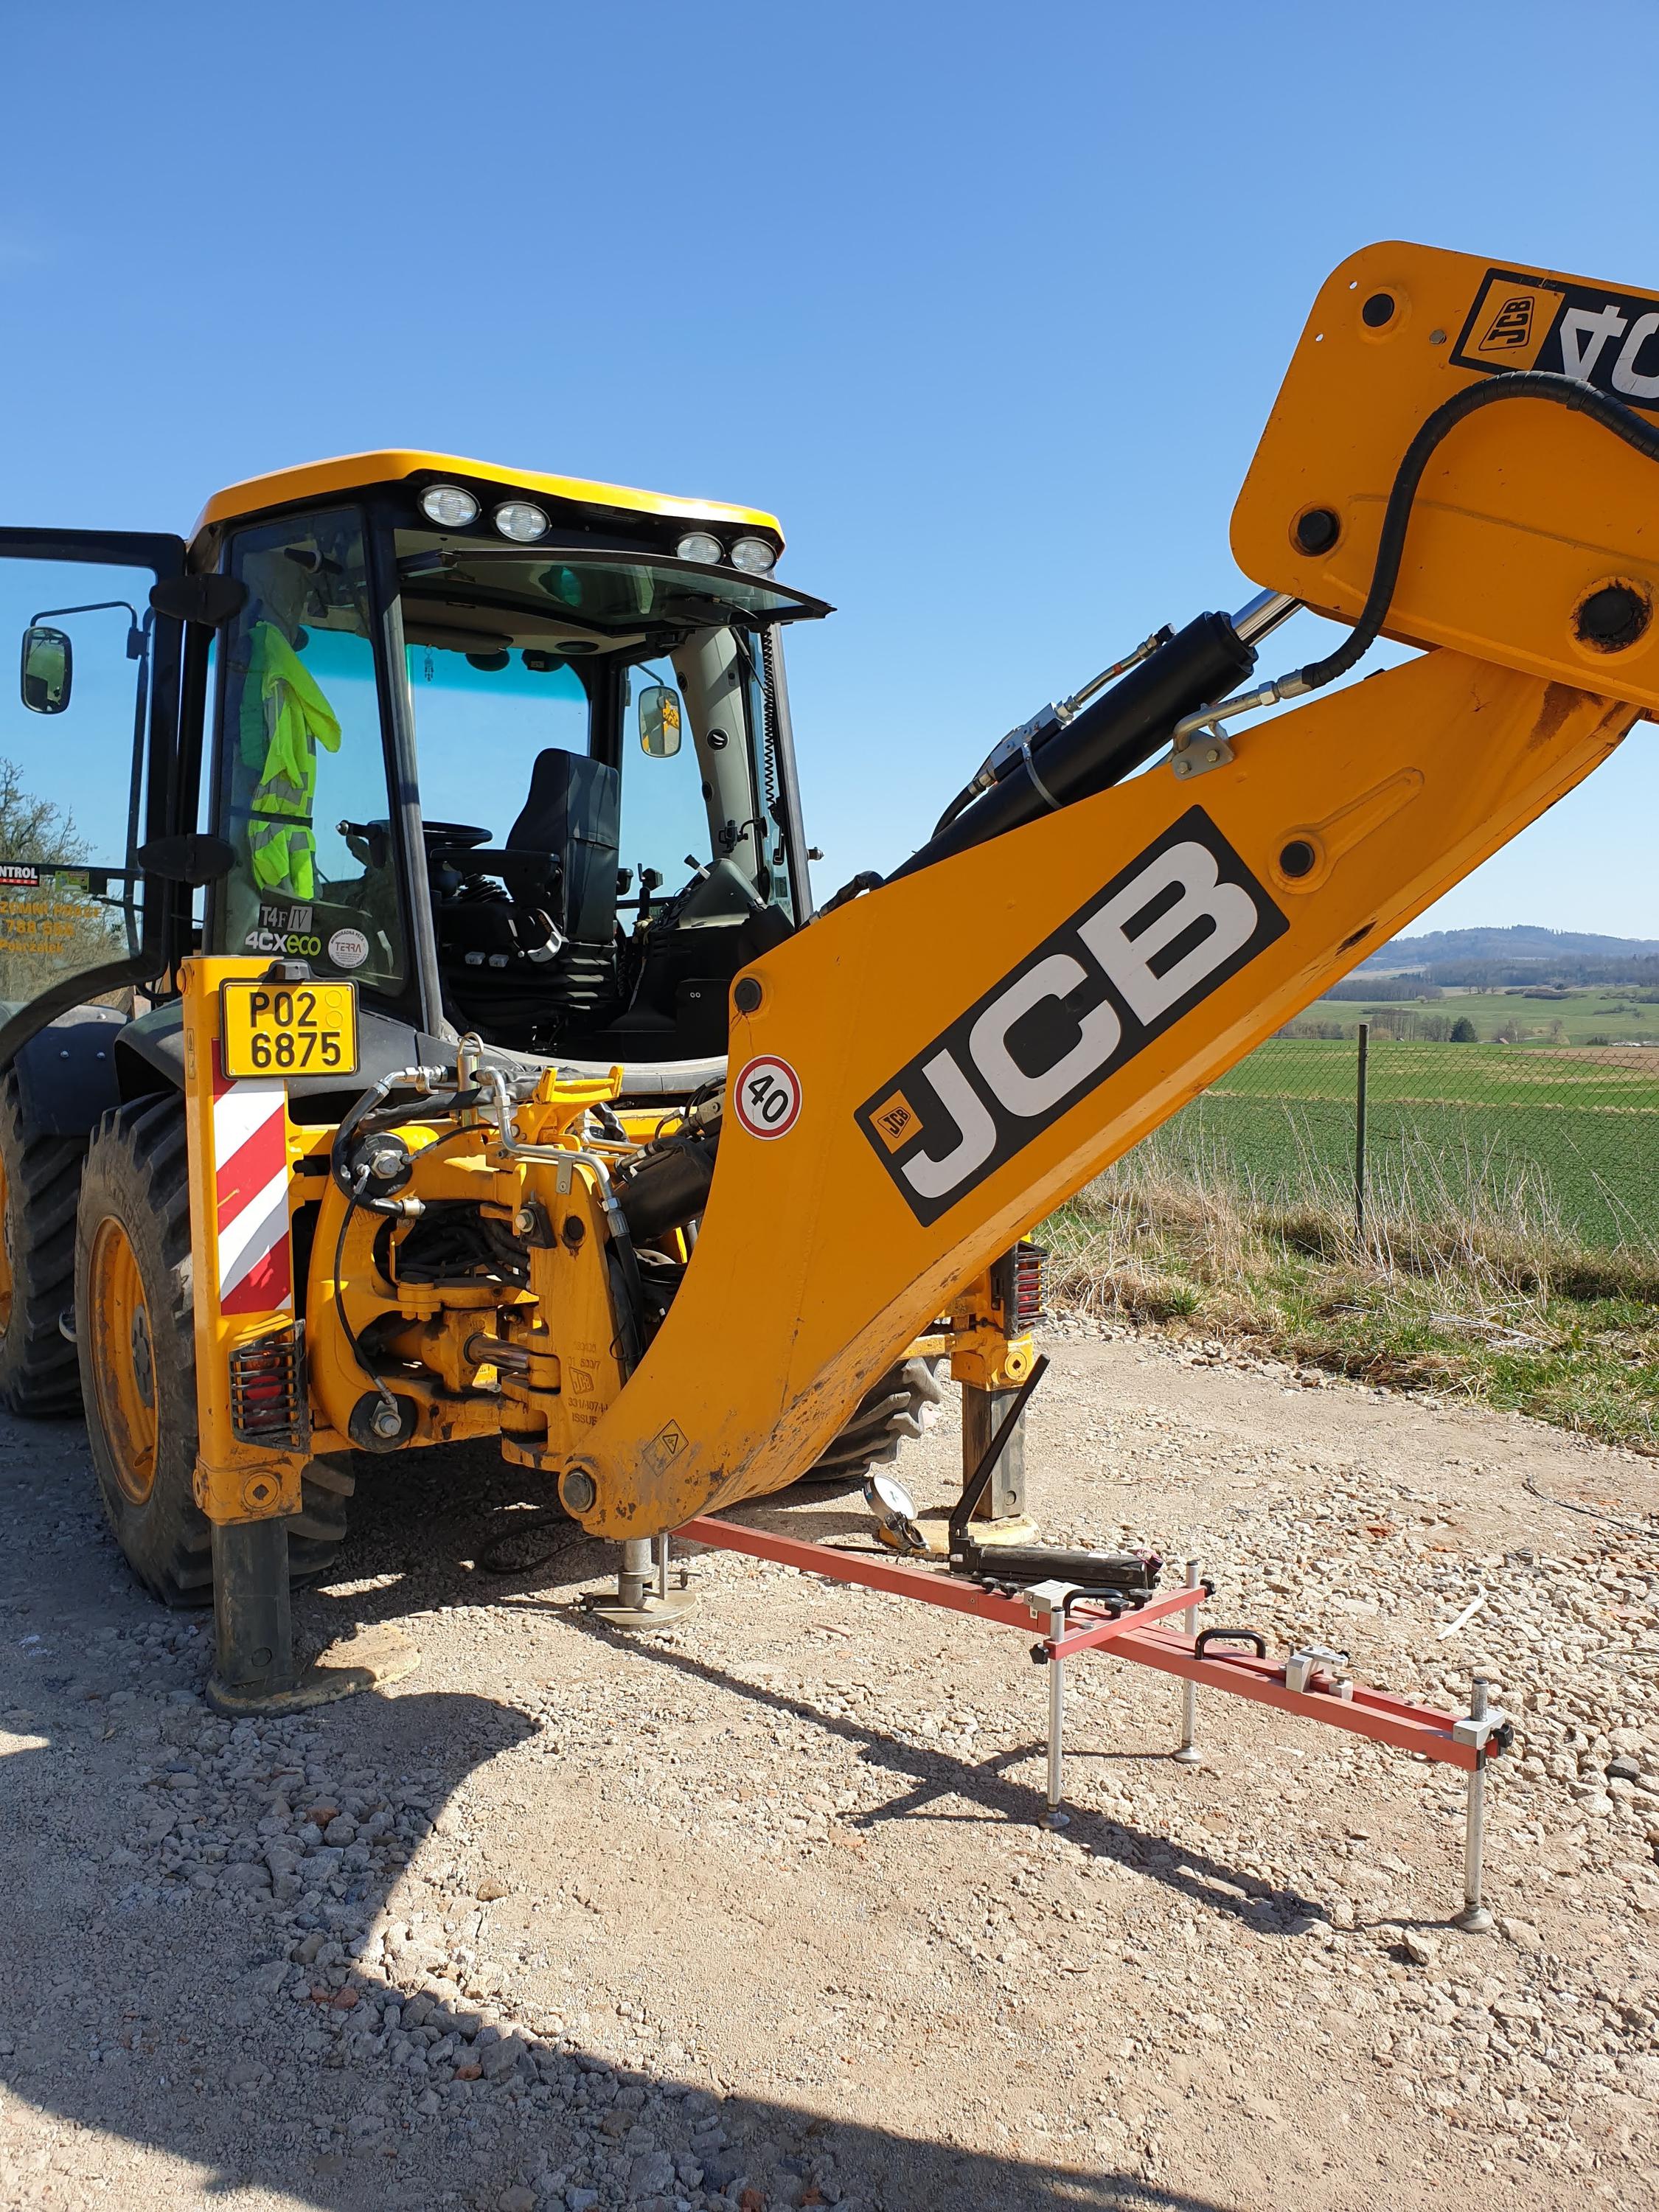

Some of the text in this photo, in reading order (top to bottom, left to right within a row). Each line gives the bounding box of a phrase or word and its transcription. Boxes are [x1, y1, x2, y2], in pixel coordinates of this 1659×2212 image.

[1487, 300, 1531, 344] JCB
[335, 942, 362, 953] TERRA
[249, 992, 317, 1028] P02
[901, 841, 1259, 1199] JCB
[251, 1032, 341, 1068] 6875
[748, 1074, 789, 1123] 40
[883, 1108, 909, 1135] JCB
